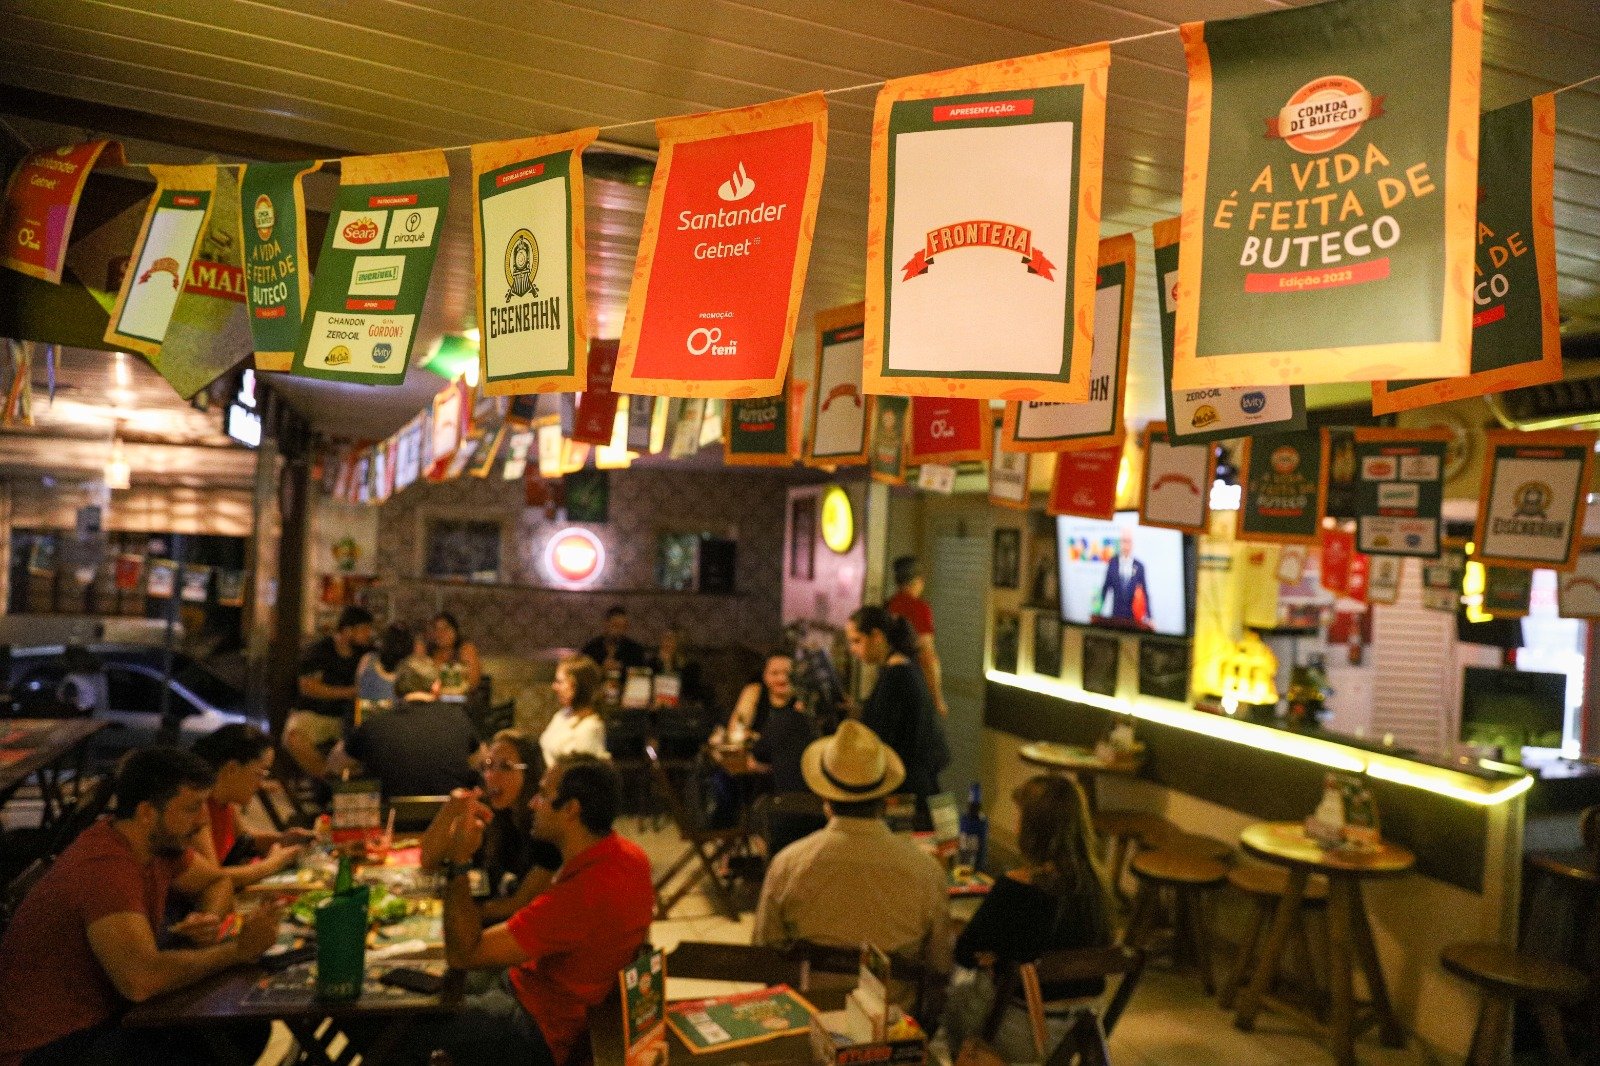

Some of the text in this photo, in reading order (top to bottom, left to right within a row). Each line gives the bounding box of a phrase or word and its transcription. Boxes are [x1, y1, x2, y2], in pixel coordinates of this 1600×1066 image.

[950, 104, 1015, 116] APRESENTAÇÃO:
[1298, 101, 1348, 118] COMIDA
[1291, 119, 1305, 131] DI
[1250, 143, 1389, 193] A VIDA
[1213, 162, 1435, 231] É FEITA DE
[677, 202, 786, 231] Santander
[344, 226, 376, 239] Seara
[393, 231, 425, 244] piraquê
[929, 222, 1029, 253] FRONTERA
[1240, 215, 1400, 269] BUTECO
[261, 239, 281, 261] VIDA
[694, 239, 752, 260] Getnet
[1488, 232, 1528, 269] DE
[1279, 271, 1353, 289] Edição 2023
[253, 281, 288, 306] BUTECO
[328, 316, 365, 326] CHANDON
[490, 296, 560, 338] EISENBAHN
[699, 310, 734, 319] PROMOÇÃO:
[711, 345, 736, 356] tem
